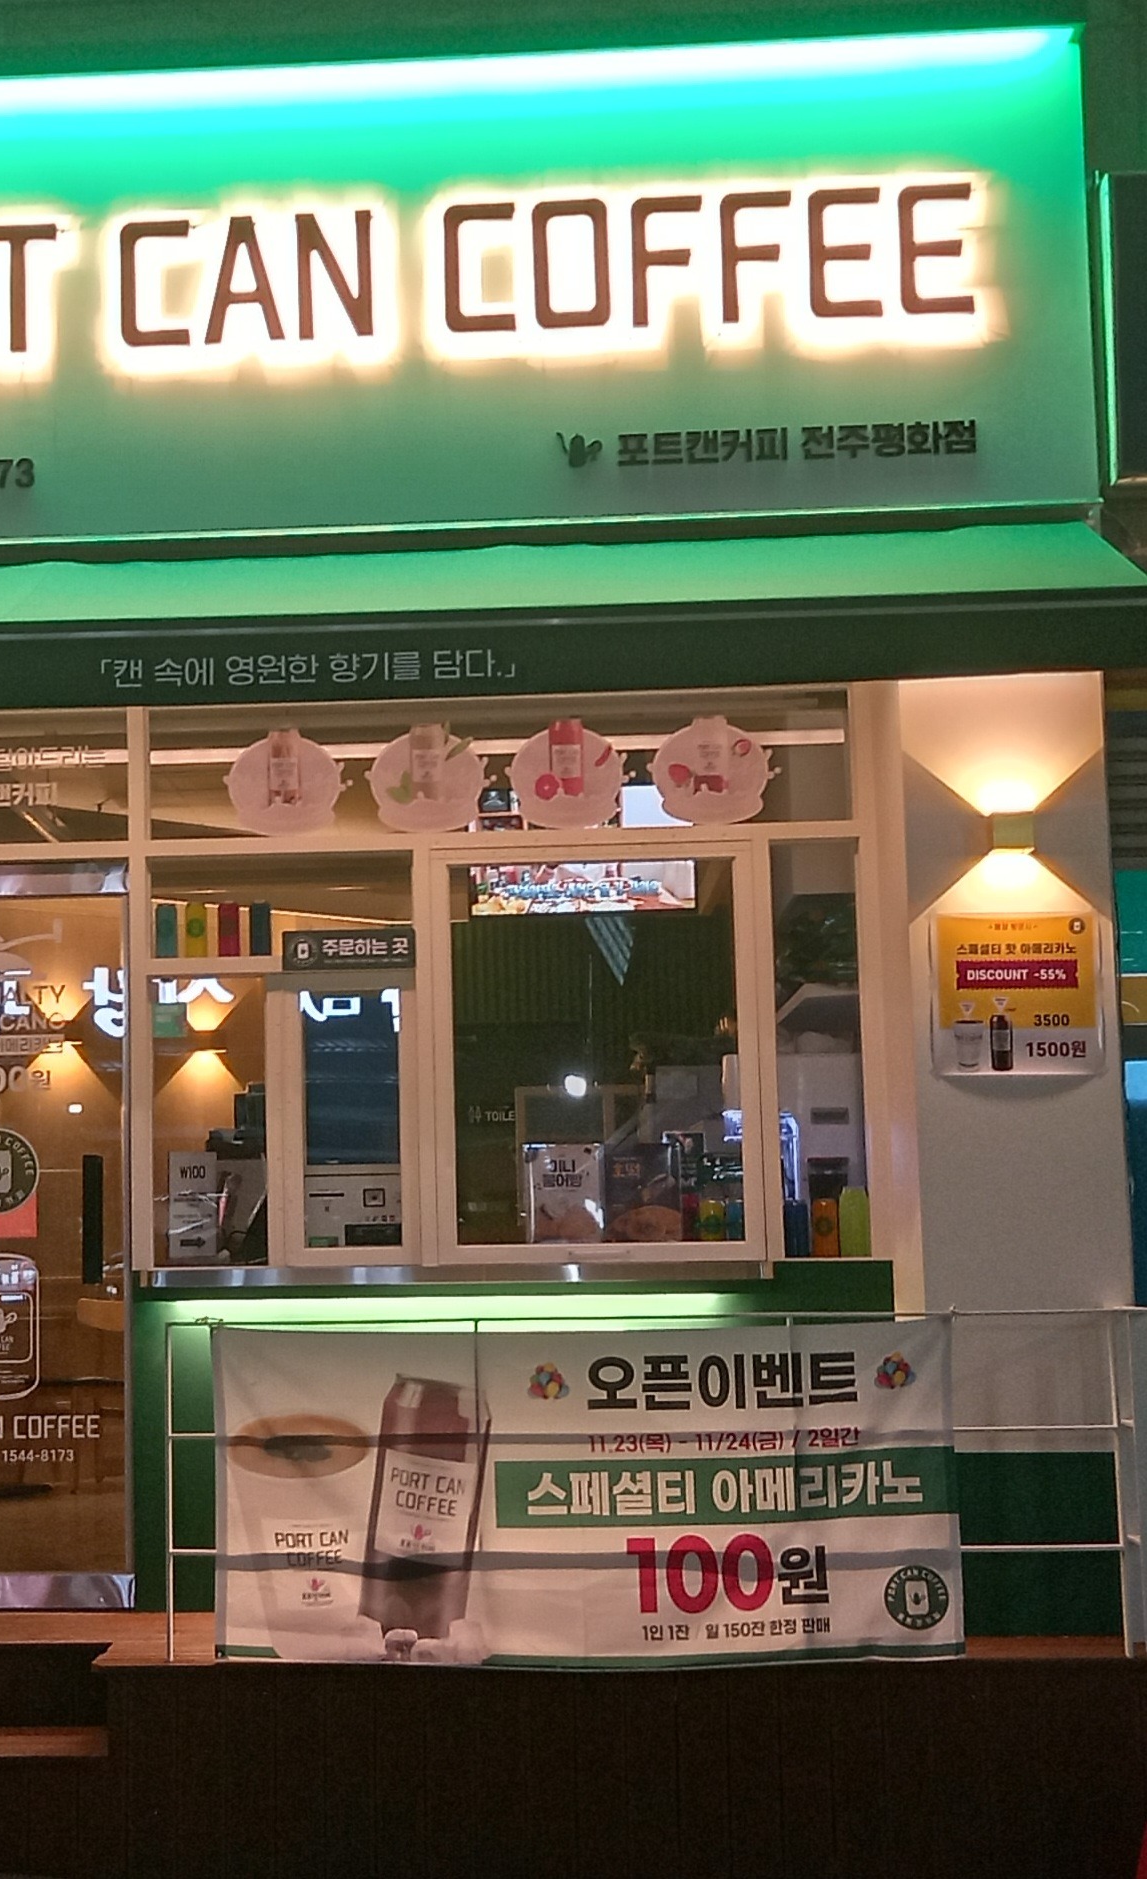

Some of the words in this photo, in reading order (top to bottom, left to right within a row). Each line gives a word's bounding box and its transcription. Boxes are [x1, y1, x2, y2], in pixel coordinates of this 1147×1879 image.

[120, 210, 374, 347] CAN
[444, 183, 975, 332] COFFEE
[617, 427, 789, 467] 포트캔커피
[800, 420, 977, 460] 전주평화점
[154, 657, 215, 687] 속에
[225, 653, 319, 686] 영원한
[329, 651, 421, 683] 향기를
[322, 938, 388, 956] 주문하는
[392, 937, 408, 954] 곳
[1020, 942, 1077, 955] 아메리카노
[966, 968, 1029, 981] DISCOUNT
[1033, 968, 1066, 980] -55%
[1033, 1014, 1070, 1027] 3500
[1026, 1041, 1087, 1058] 1500원
[4, 1137, 34, 1176] COFFEE
[587, 1351, 858, 1410] 오픈이벤트
[13, 1415, 101, 1439] COFFEE
[588, 1433, 672, 1453] 11.23(목)
[696, 1431, 784, 1452] 11/24(금)
[808, 1427, 861, 1448] 2일간
[2, 1449, 74, 1463] 1544-8173
[391, 1467, 430, 1490] PORT
[436, 1475, 466, 1495] CAN
[527, 1470, 695, 1515] 스페셜티
[711, 1460, 923, 1513] 아메리카노
[396, 1490, 458, 1516] COFFEE
[274, 1532, 313, 1548] PORT
[319, 1529, 349, 1545] CAN
[286, 1549, 343, 1568] COFFEE
[626, 1532, 830, 1613] 100원
[642, 1625, 663, 1641] 1인
[668, 1624, 690, 1640] 1잔
[705, 1623, 719, 1639] 일
[724, 1621, 765, 1638] 150잔
[769, 1619, 797, 1636] 한정
[801, 1617, 831, 1634] 판매
